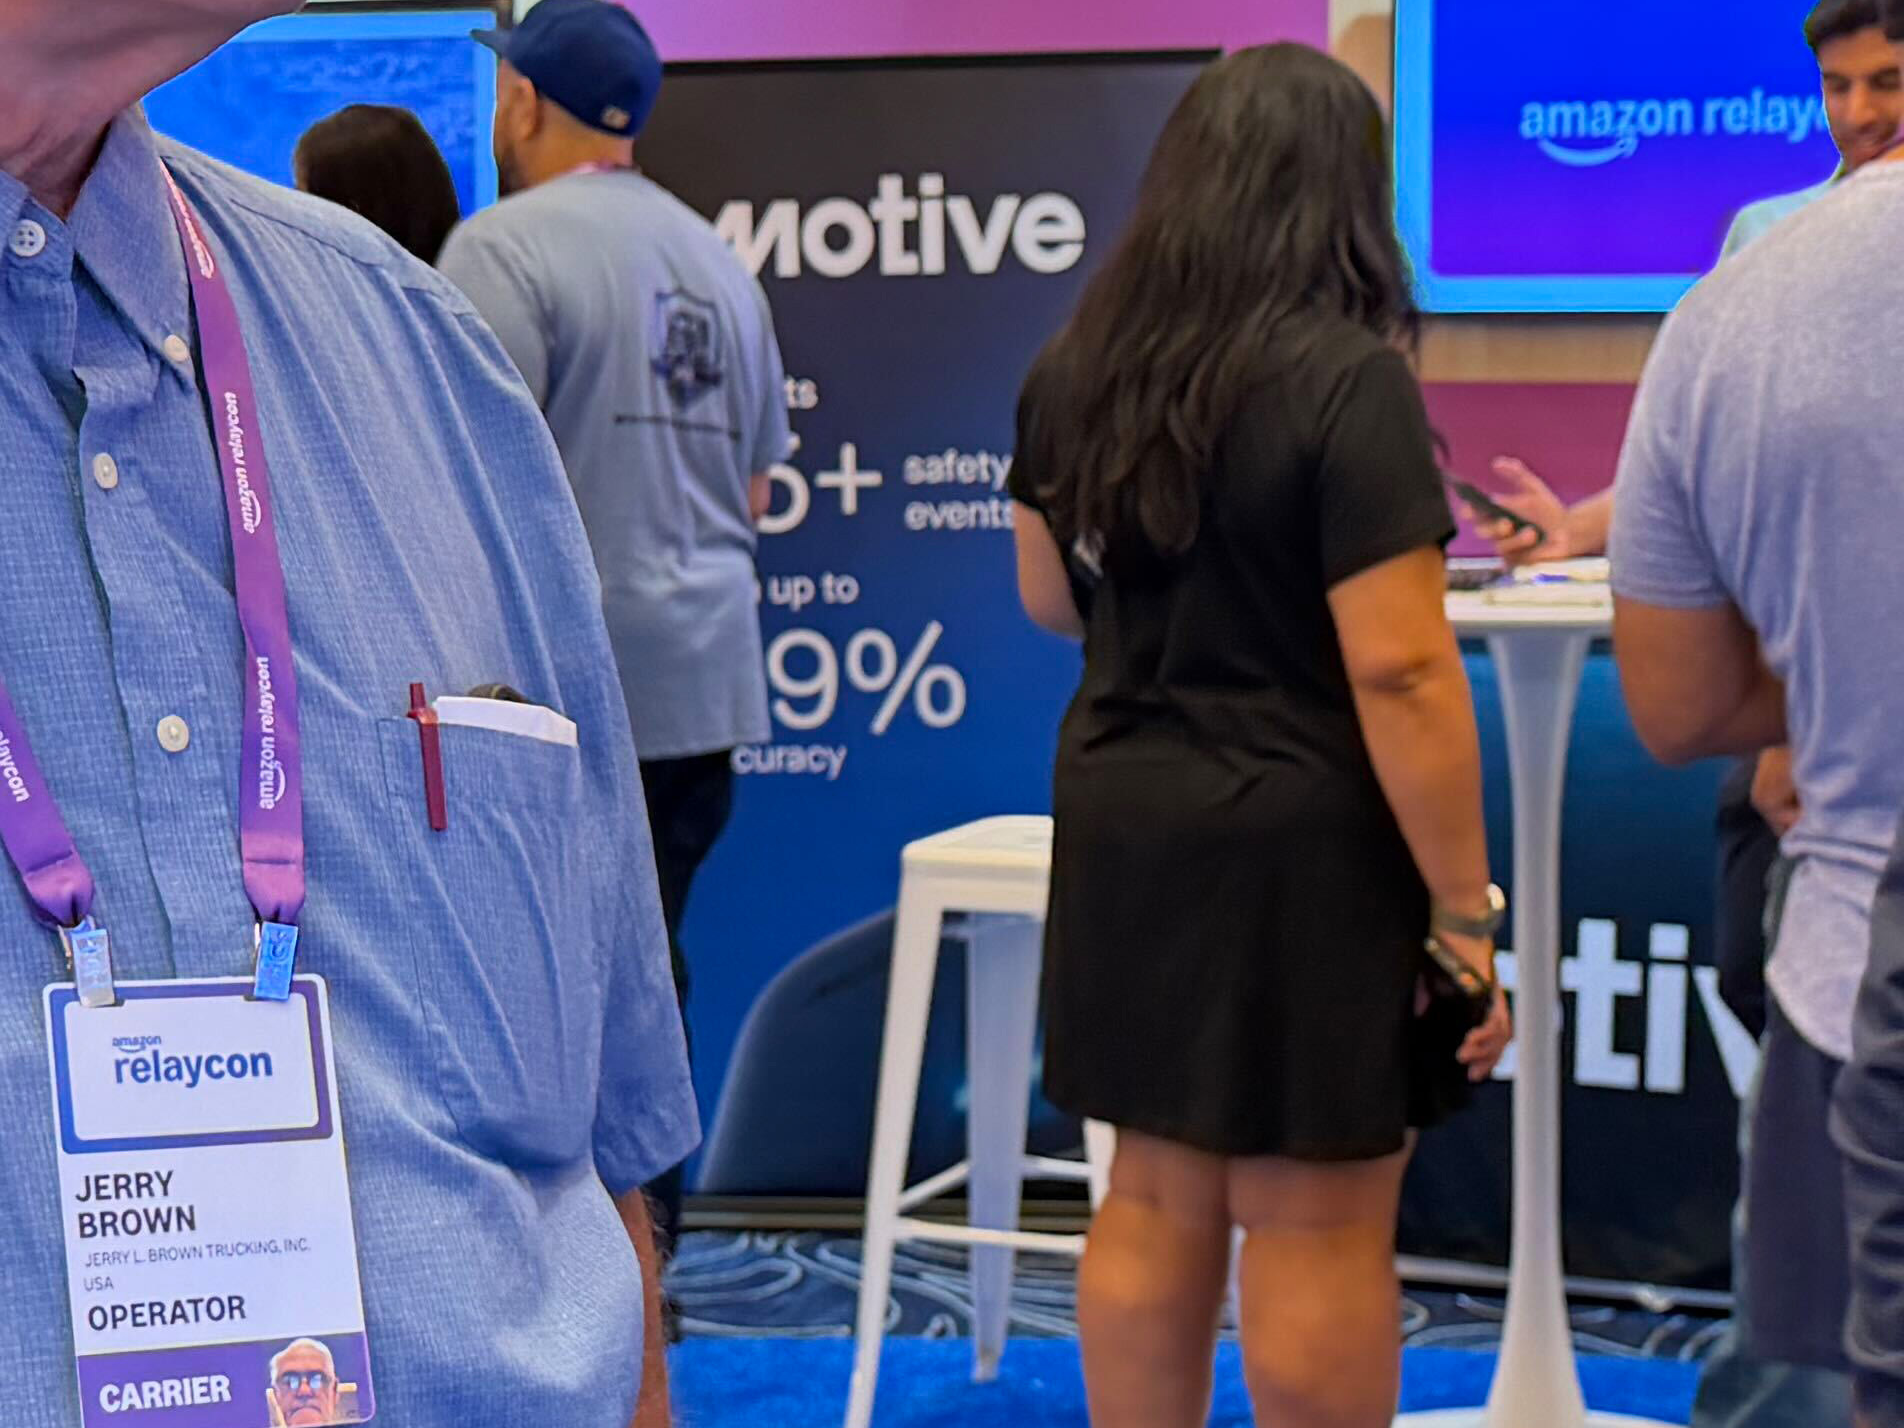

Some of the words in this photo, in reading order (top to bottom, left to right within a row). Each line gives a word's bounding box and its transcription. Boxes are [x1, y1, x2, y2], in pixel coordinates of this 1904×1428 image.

[1518, 96, 1694, 142] amazon
[1701, 85, 1830, 144] relay
[224, 391, 246, 466] relaycon
[903, 448, 1014, 492] safety
[235, 467, 256, 534] amazon
[767, 575, 816, 613] up
[820, 571, 861, 605] to
[256, 656, 276, 733] relaycon
[766, 619, 967, 737] 9%
[259, 737, 278, 810] amazon
[730, 744, 848, 781] curacy
[112, 1035, 162, 1049] amazon
[114, 1049, 273, 1089] relaycon
[75, 1170, 174, 1202] JERRY
[78, 1204, 197, 1239] BROWN
[85, 1251, 129, 1268] JERRY
[148, 1245, 203, 1262] BROWN
[205, 1239, 282, 1258] TRUCKING,
[83, 1276, 114, 1292] USA
[87, 1294, 247, 1332] OPERATOR
[99, 1373, 232, 1413] CARRIER
